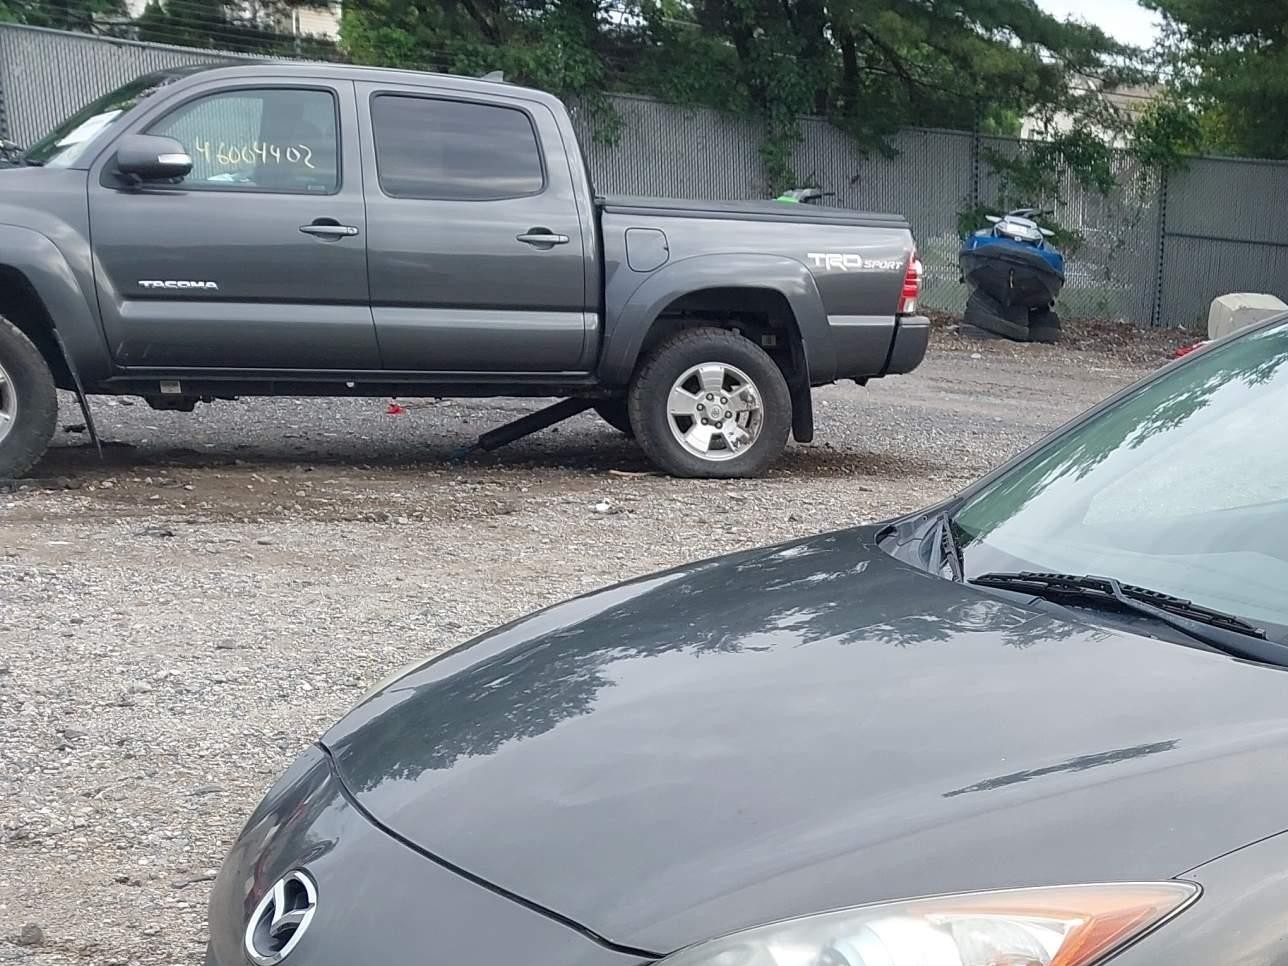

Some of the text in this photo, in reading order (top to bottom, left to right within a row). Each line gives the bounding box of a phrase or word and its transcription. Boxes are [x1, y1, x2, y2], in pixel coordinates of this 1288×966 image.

[195, 136, 316, 169] 46004402
[807, 252, 904, 272] TRD SPORT
[138, 280, 219, 290] TACOMA
